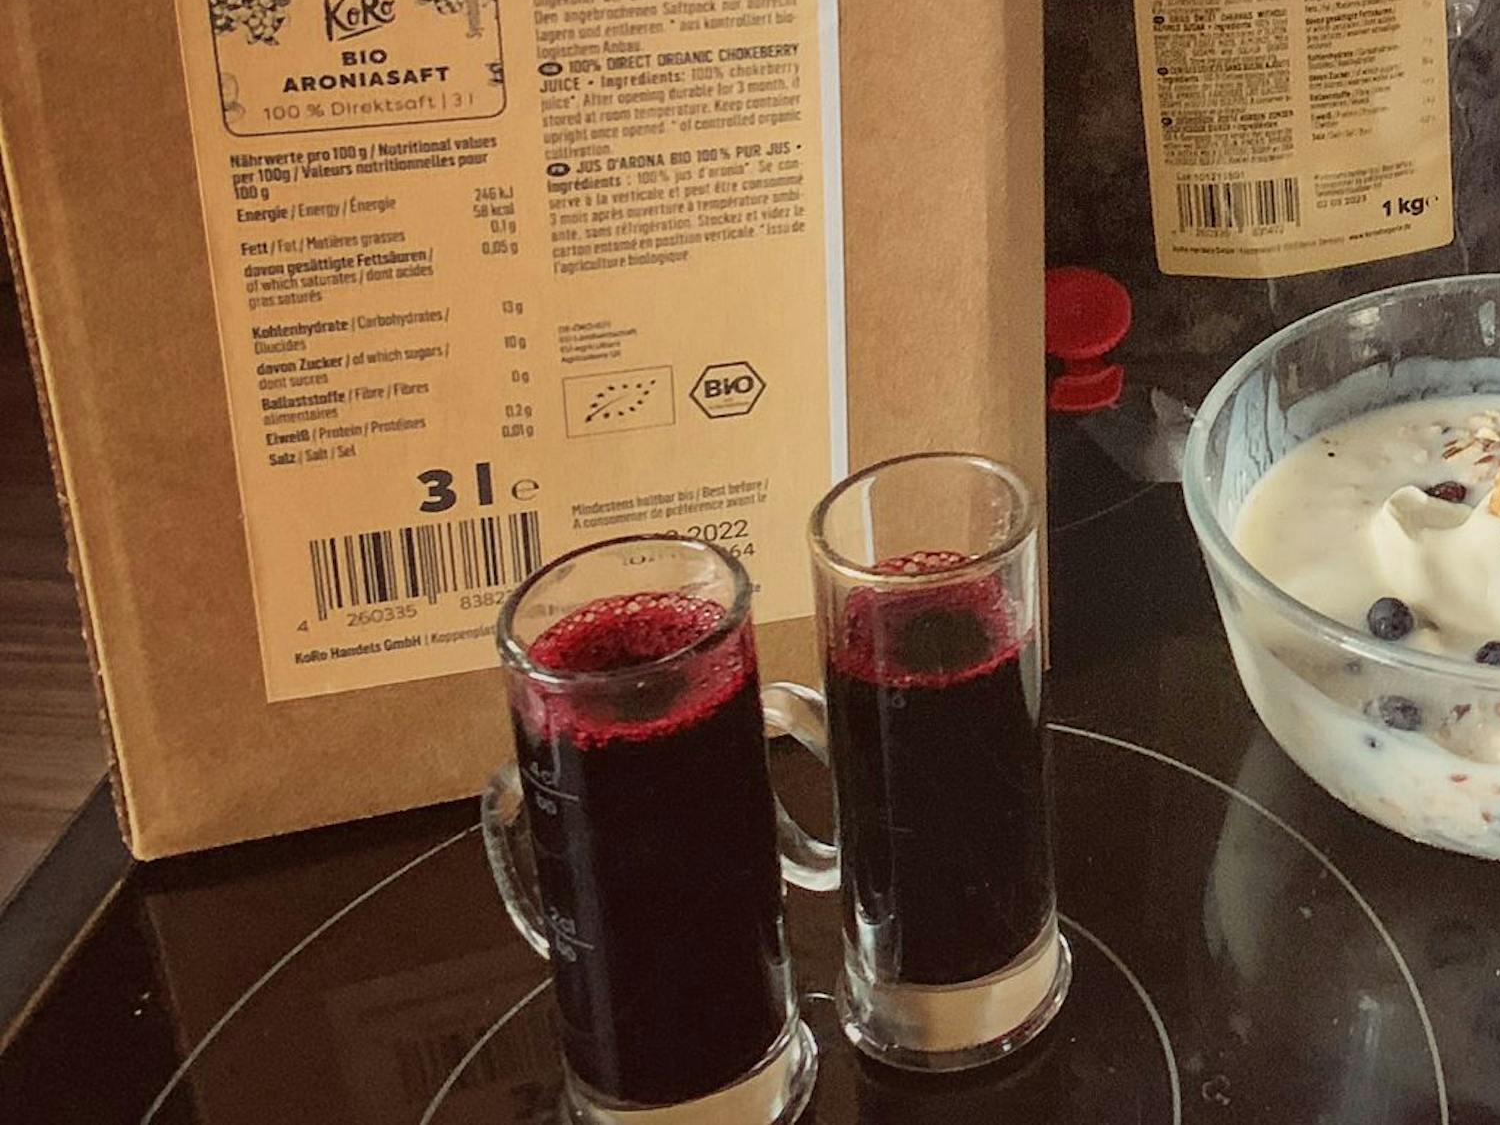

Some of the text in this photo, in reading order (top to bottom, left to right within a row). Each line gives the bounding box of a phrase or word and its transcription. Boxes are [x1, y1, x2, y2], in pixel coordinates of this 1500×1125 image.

[341, 49, 388, 66] BIO
[568, 43, 799, 74] 100% DIRECT ORGANIC CHOKEBERRY
[281, 66, 451, 93] ARONIASAFT
[540, 78, 580, 93] JUICE
[263, 104, 300, 122] 100
[306, 103, 324, 118] %
[331, 95, 435, 116] Direktsaft
[453, 93, 464, 107] 3
[229, 149, 303, 169] Nährwerte
[306, 150, 331, 164] pro
[332, 146, 353, 160] 100
[378, 138, 451, 157] Nutritional
[454, 135, 497, 151] values
[576, 159, 602, 173] JUS
[670, 151, 691, 164] BIO
[736, 144, 760, 158] PUR
[766, 141, 790, 155] JUS
[232, 152, 489, 185] per 100g Valeurs nutritionnelles pour
[234, 186, 258, 200] 100
[474, 187, 496, 202] 246
[1382, 196, 1424, 217] 1 kg
[236, 193, 396, 224] Energie Energy Énergie
[473, 201, 515, 218] 58 kcal
[240, 241, 269, 257] Fett
[277, 240, 296, 253] Fat
[243, 248, 426, 278] davon gesättigte Fettsäuren
[261, 276, 298, 292] which
[300, 271, 357, 288] saturates
[365, 267, 393, 282] dont
[395, 264, 433, 279] acides
[251, 308, 443, 342] Kohlenhydrate Carbohydrates
[256, 360, 296, 376] davon
[299, 355, 343, 371] Zucker
[351, 353, 365, 366] of
[367, 349, 402, 364] which
[261, 380, 429, 412] Ballaststoffe Fibre Fibres
[703, 374, 755, 398] BIO
[265, 415, 426, 446] Eiweiß Protein Protéines
[268, 451, 296, 467] Salz
[415, 466, 458, 515] 3
[475, 461, 494, 506] l
[295, 619, 309, 633] 4
[346, 603, 418, 628] 260335
[294, 648, 328, 665] KoRo
[330, 640, 382, 659] Handels
[383, 634, 421, 651] GmbH
